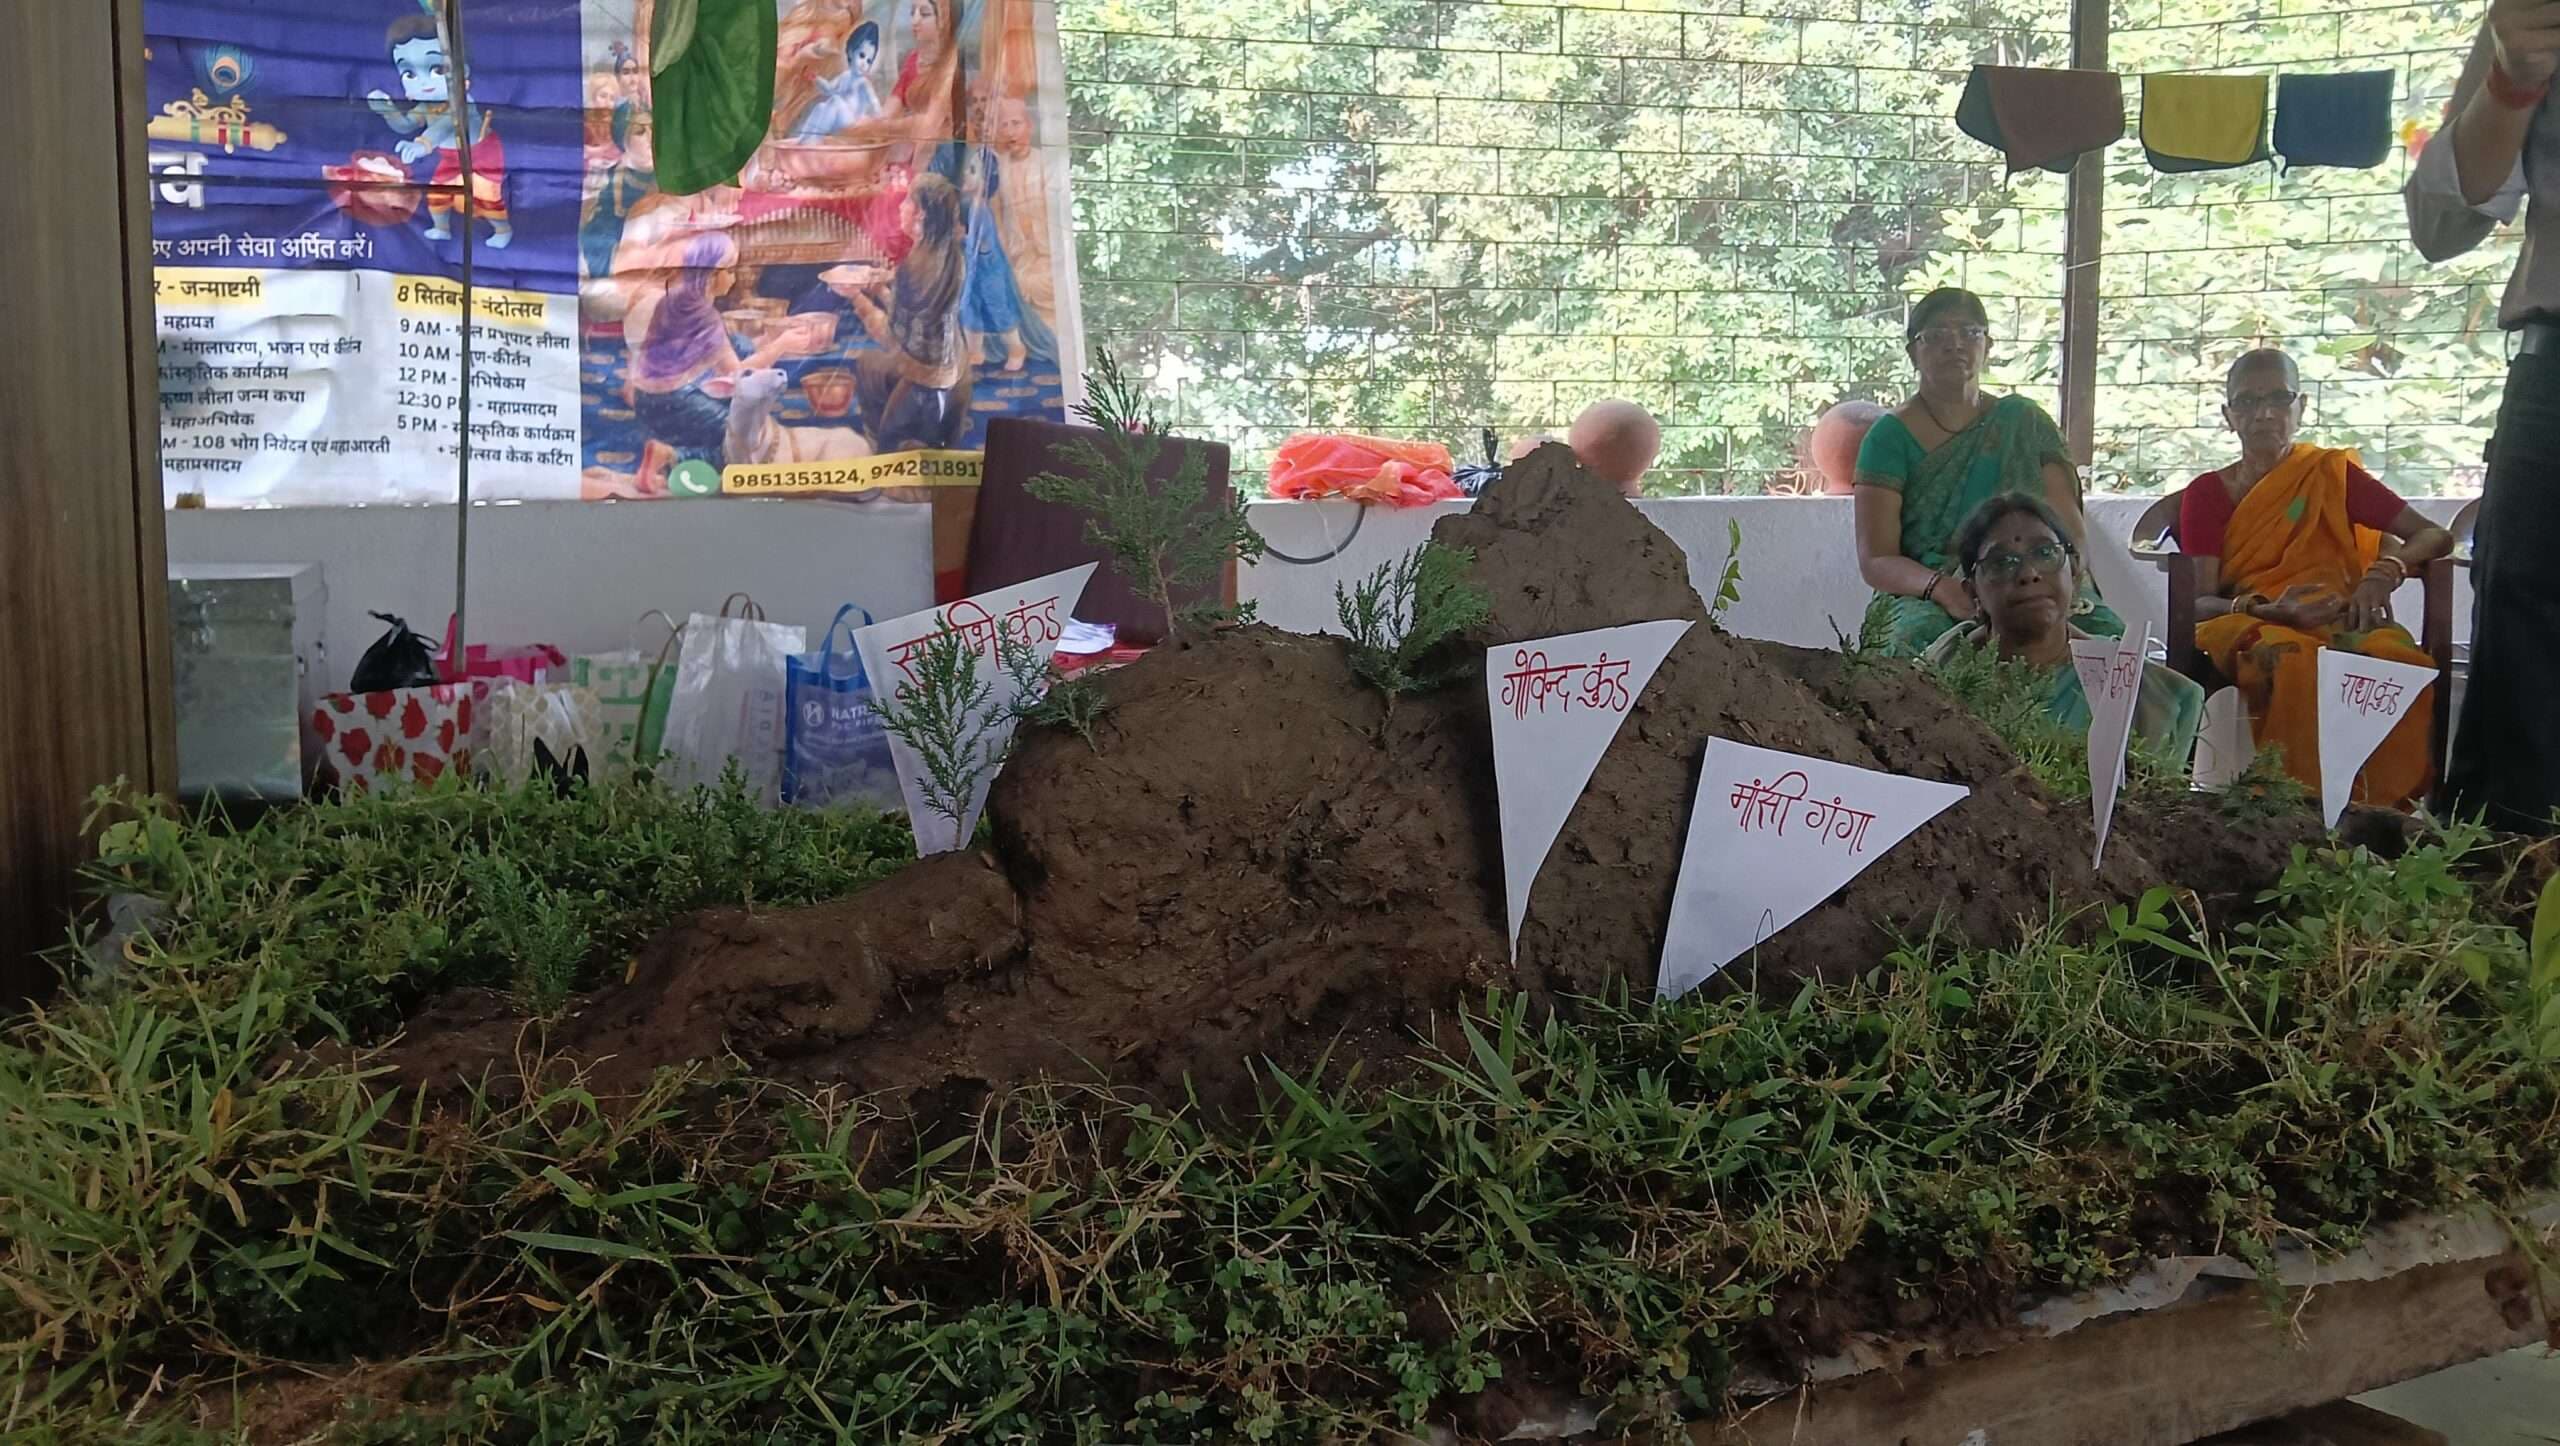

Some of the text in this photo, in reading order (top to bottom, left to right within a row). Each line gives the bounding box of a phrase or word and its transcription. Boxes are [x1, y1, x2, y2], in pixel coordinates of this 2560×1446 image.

[177, 234, 231, 256] अपनी
[237, 232, 274, 258] सेवा
[282, 232, 334, 258] अर्पित
[180, 276, 260, 297] जन्माष्टमी
[397, 285, 409, 302] 8
[482, 295, 543, 318] नंदोत्सव
[400, 318, 410, 332] 9
[415, 321, 441, 336] AM
[487, 327, 533, 347] प्रभुपाद
[536, 331, 570, 350] लीला
[267, 341, 304, 355] भजन
[309, 339, 329, 358] एवं
[400, 343, 419, 358] 10
[423, 345, 450, 361] AM
[232, 360, 288, 379] कार्यक्रम
[400, 367, 417, 382] 12
[421, 370, 447, 385] PM
[198, 386, 233, 404] लीला
[238, 389, 268, 402] जन्म
[273, 390, 305, 403] कथा
[397, 391, 442, 409] 12:30
[488, 400, 558, 418] महाप्रसादम
[397, 415, 407, 429] 5
[412, 417, 437, 432] PM
[524, 423, 576, 443] कार्यक्रम
[192, 435, 225, 449] 108
[231, 433, 259, 450] भोग
[263, 432, 307, 452] निवेदन
[165, 457, 241, 472] महाप्रसादम
[506, 445, 533, 463] केक
[537, 447, 573, 465] कटिंग
[733, 459, 985, 493] 9851353124, 974281891
[1502, 649, 1630, 720] गोविन्द कुंड
[1806, 796, 1876, 856] गंगा
